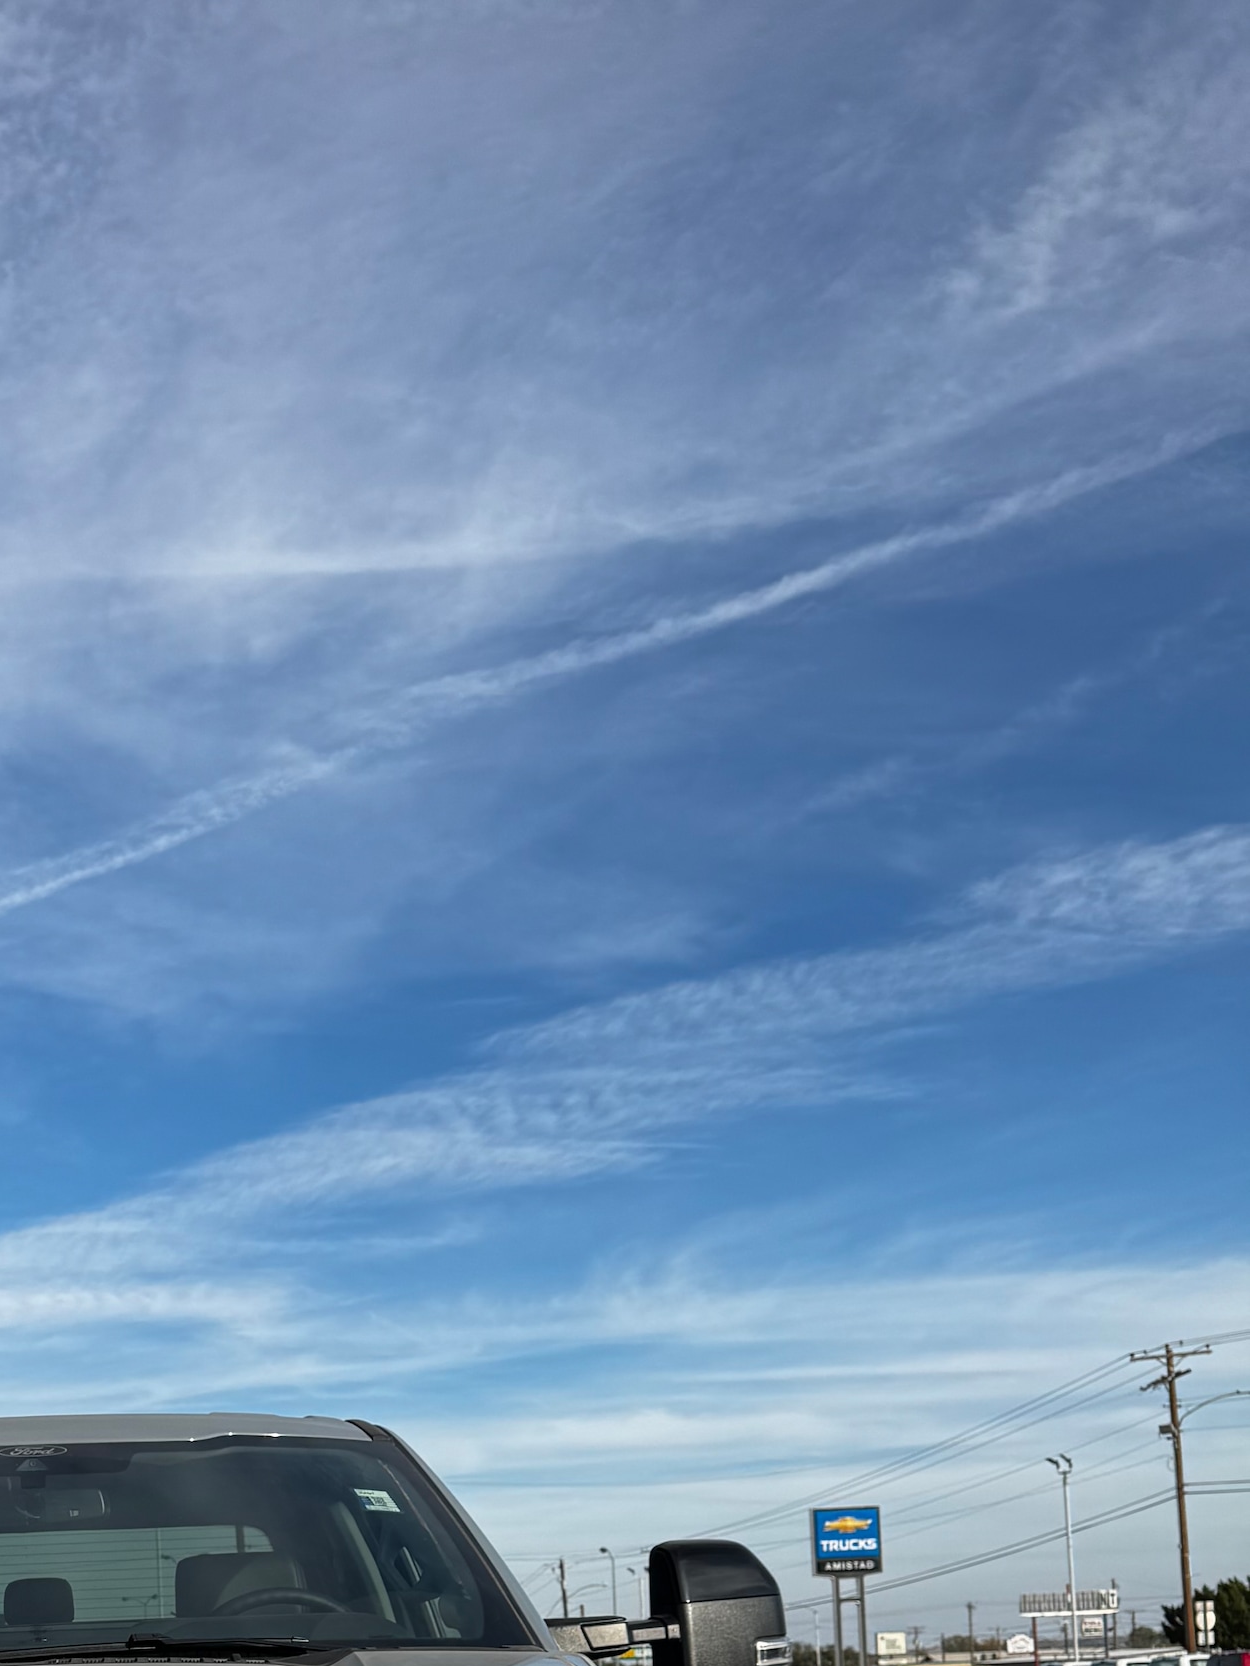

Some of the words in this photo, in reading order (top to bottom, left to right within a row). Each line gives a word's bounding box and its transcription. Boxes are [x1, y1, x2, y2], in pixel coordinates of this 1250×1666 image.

[10, 1447, 55, 1456] Ford
[820, 1538, 877, 1552] TRUCKS
[824, 1560, 875, 1571] AMISTAD
